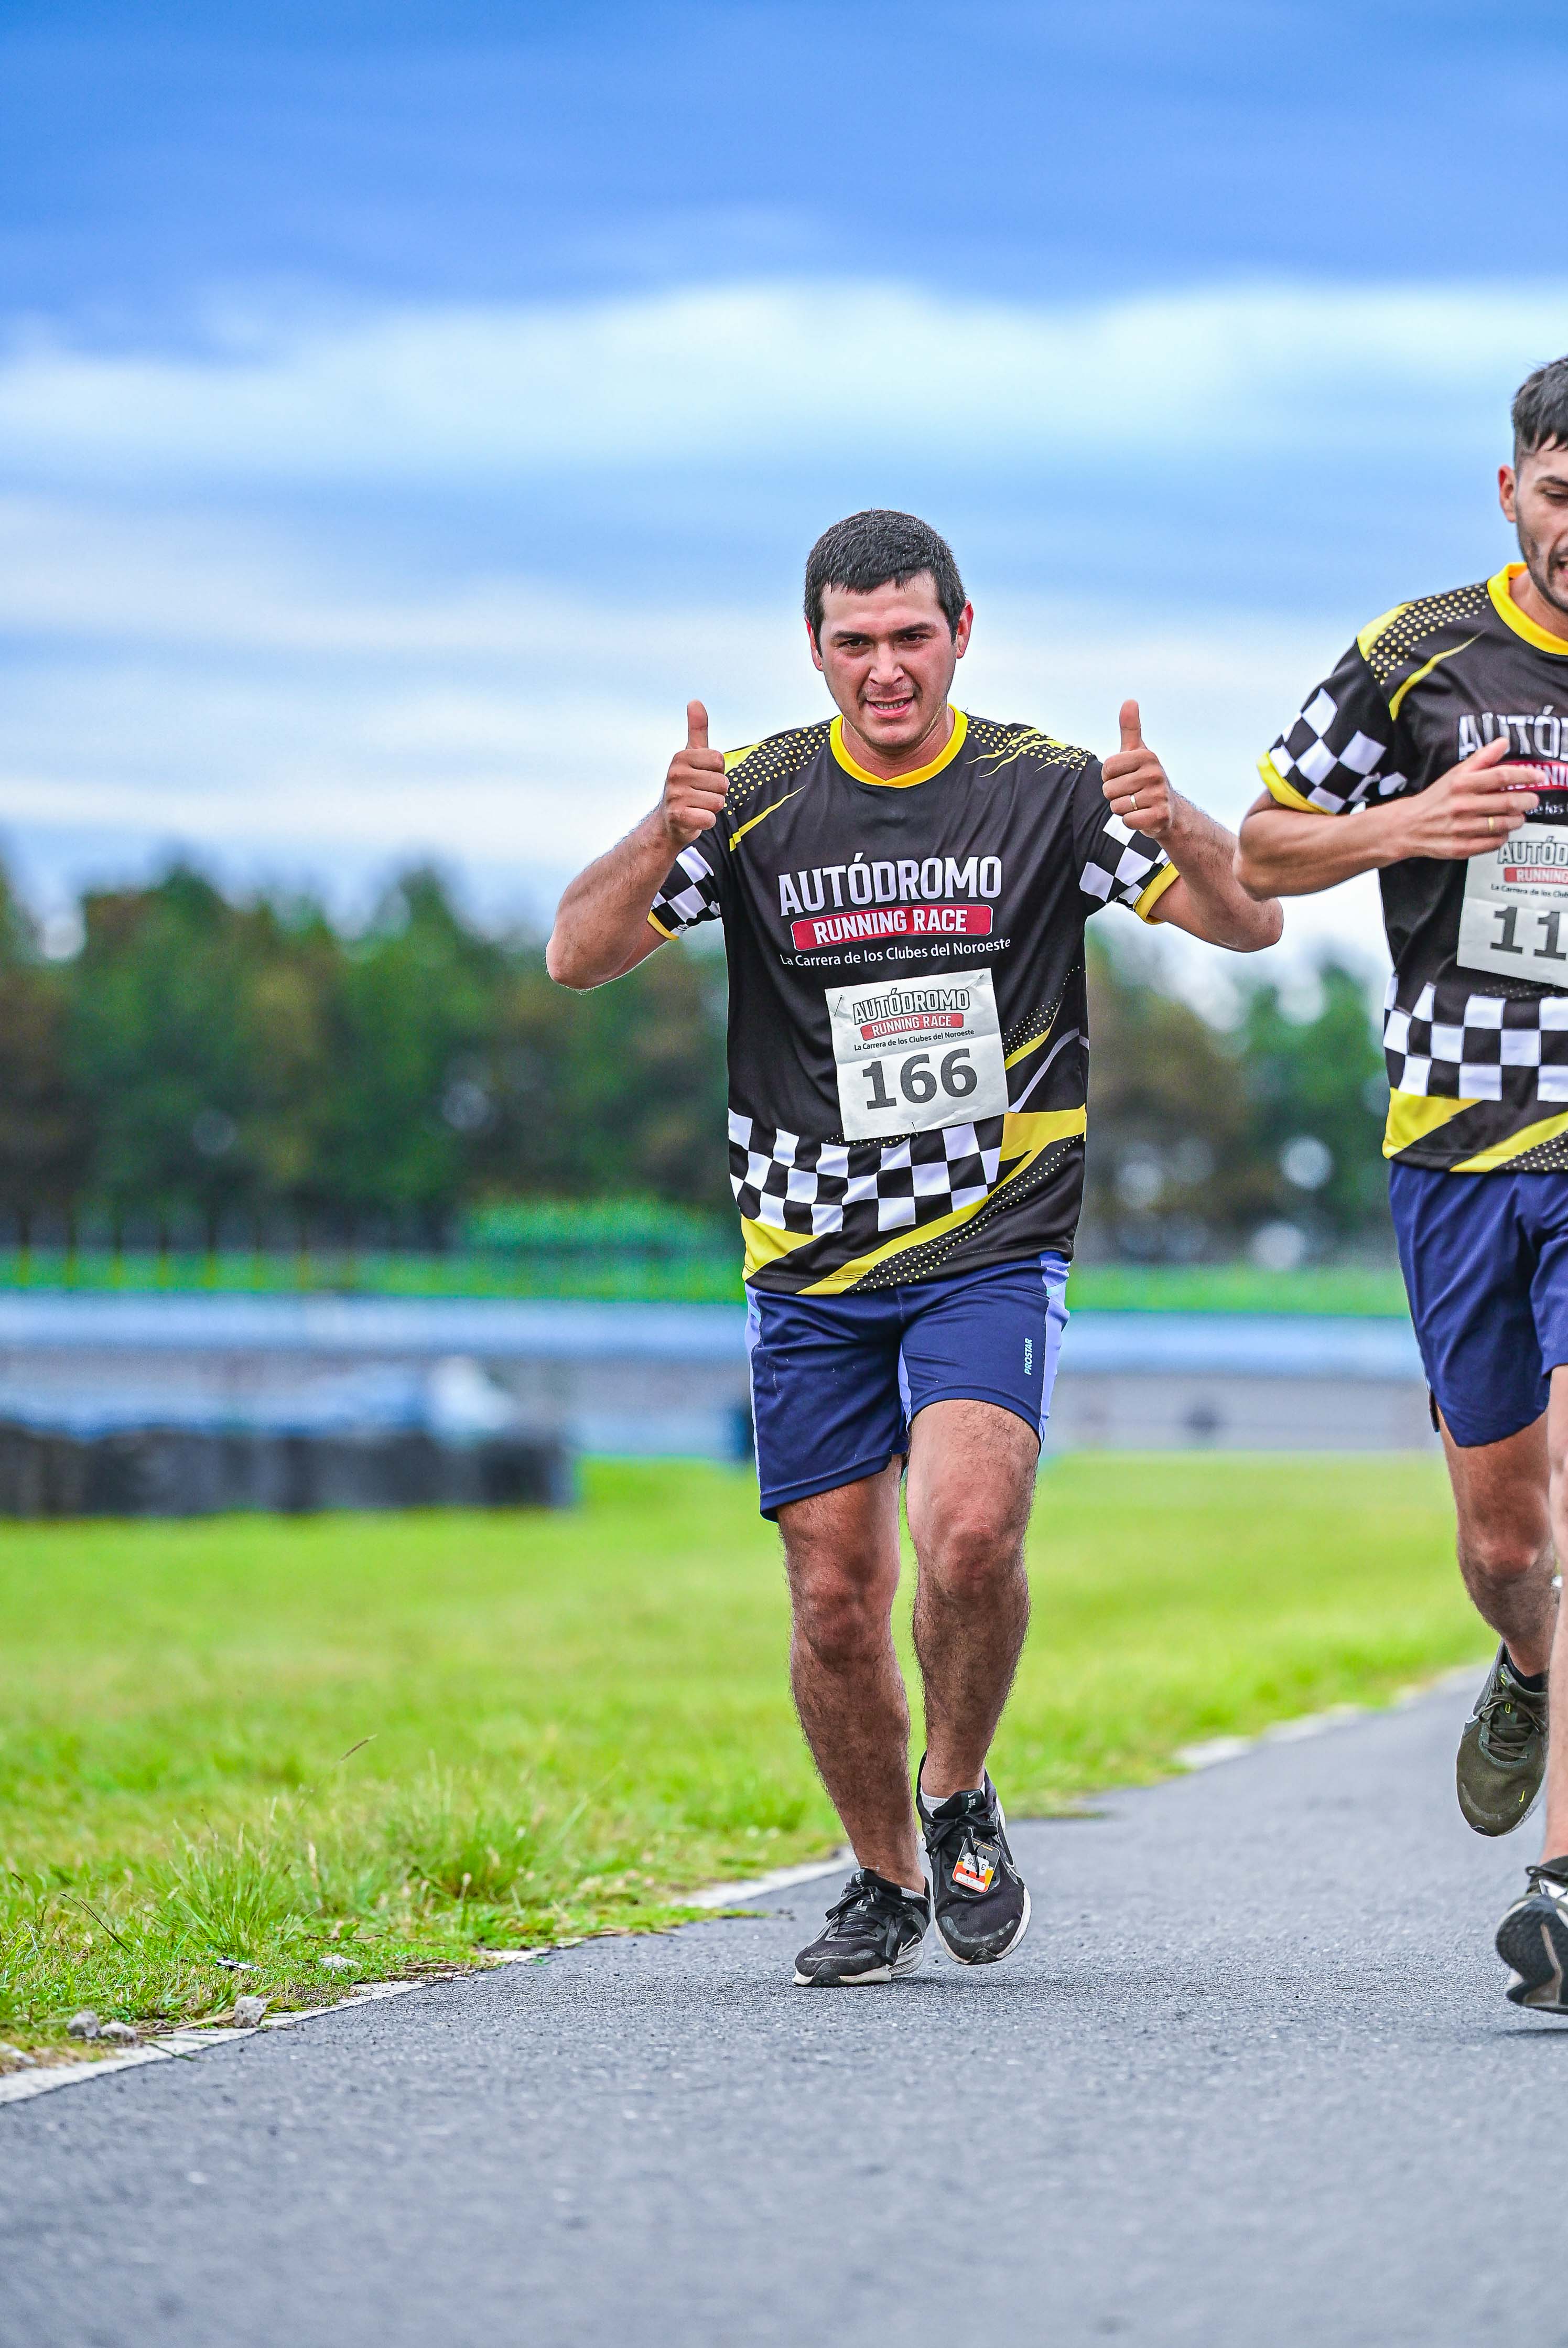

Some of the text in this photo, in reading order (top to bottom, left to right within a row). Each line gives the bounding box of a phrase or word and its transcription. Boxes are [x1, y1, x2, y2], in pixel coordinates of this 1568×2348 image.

[778, 852, 1002, 917] AUTÓDROMO
[813, 909, 968, 945] RUNNING RACE
[1490, 906, 1566, 961] 11
[780, 938, 1011, 966] La Carrera de los Clubes del Noroeste
[852, 988, 970, 1025] AUTÓDROMO
[862, 1041, 886, 1050] Carrera
[909, 1035, 932, 1043] Clubes
[945, 1029, 975, 1039] Noroeste
[871, 1015, 952, 1038] RUNNING RACE
[862, 1048, 978, 1110] 166
[1024, 1338, 1033, 1375] PROSTAR
